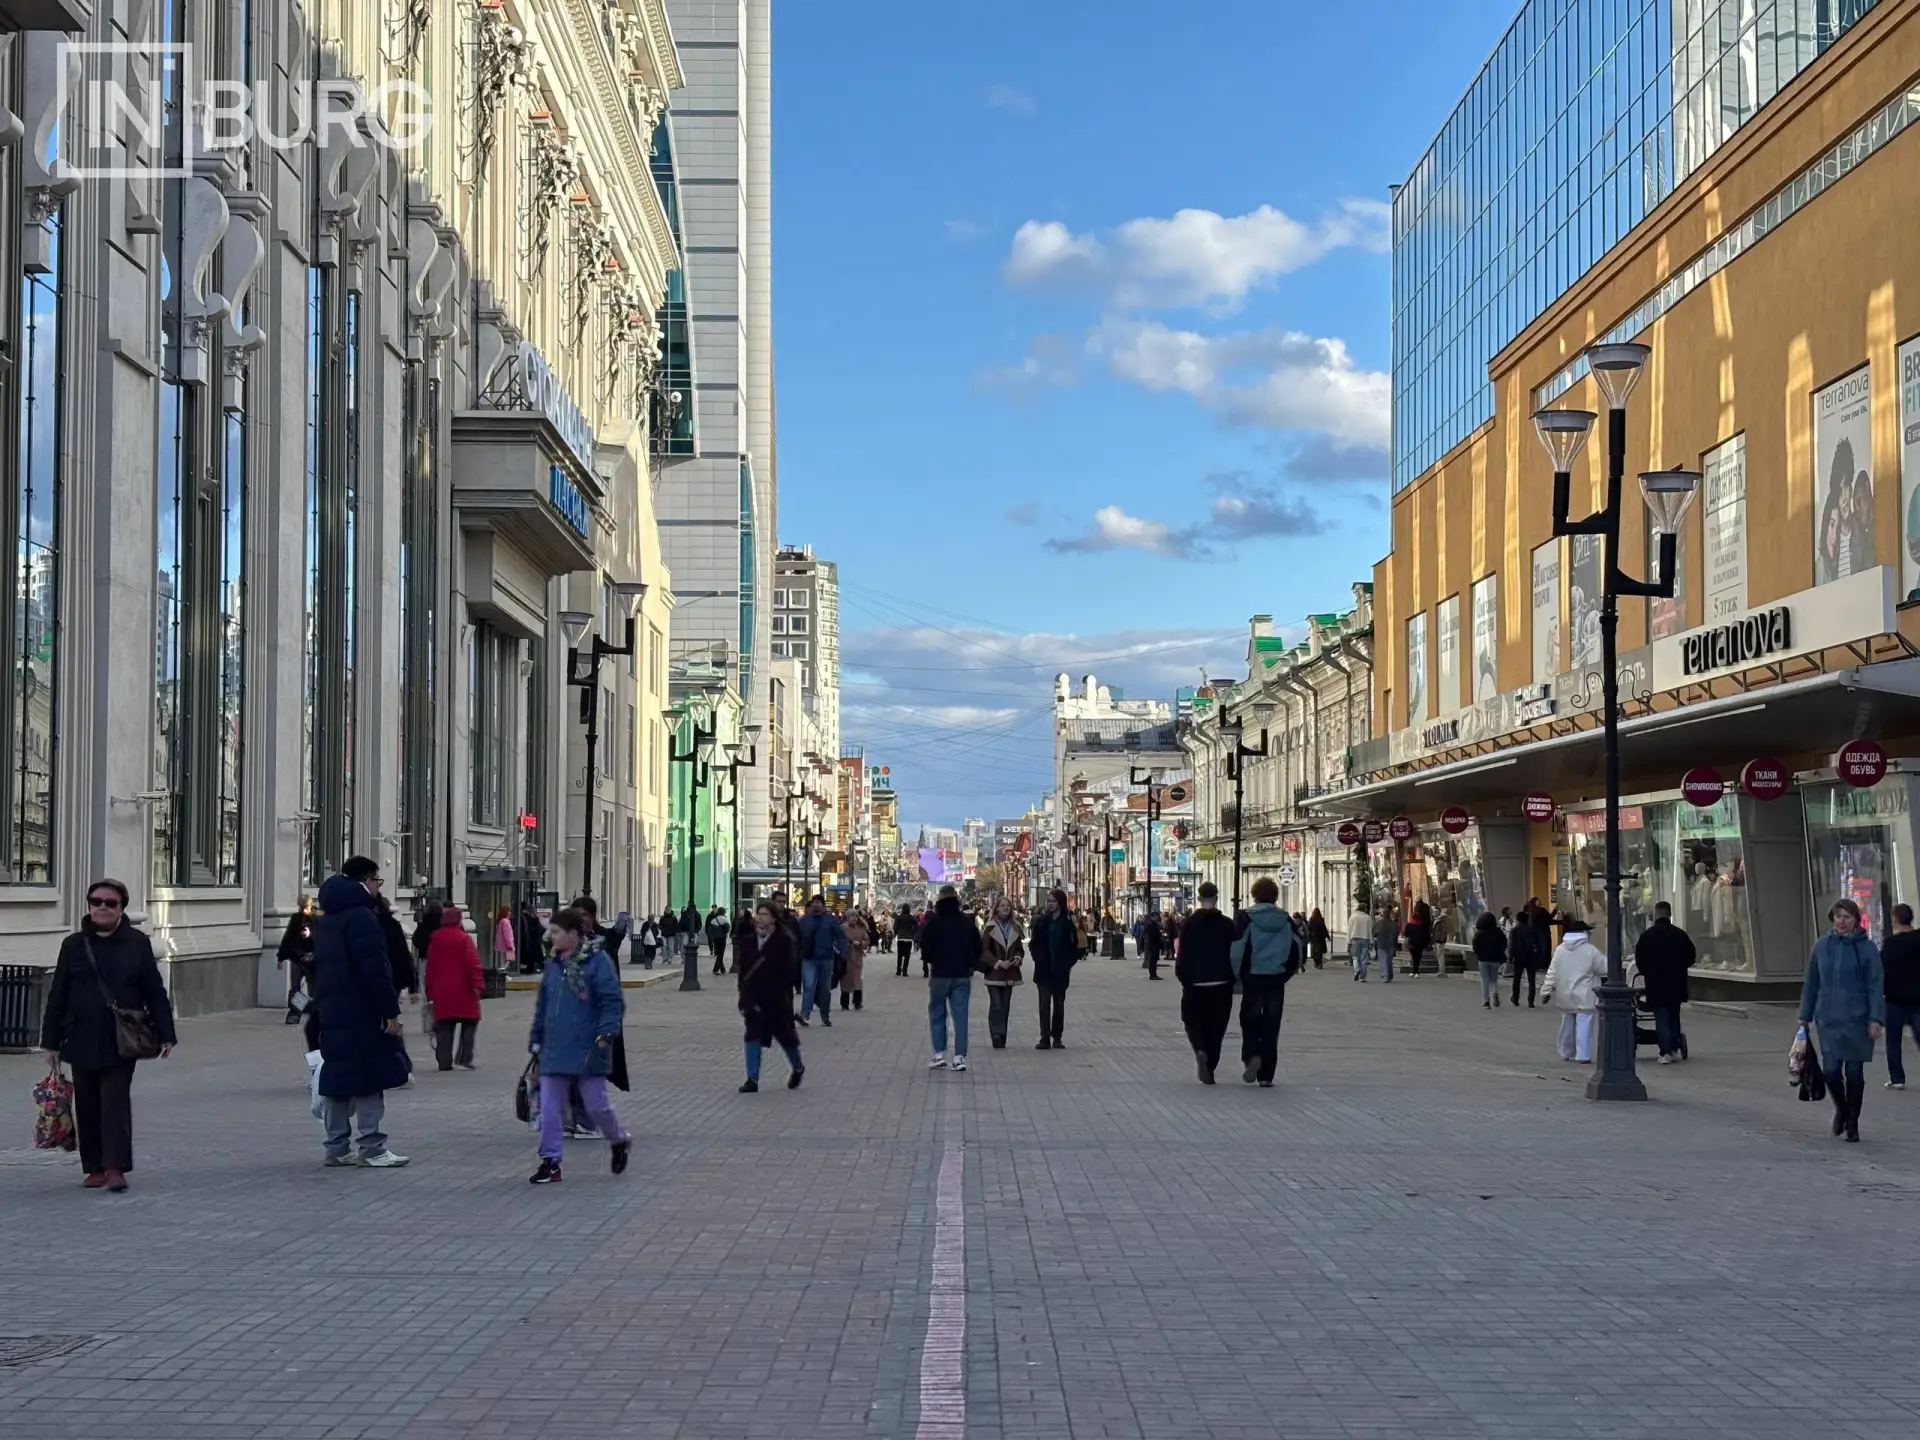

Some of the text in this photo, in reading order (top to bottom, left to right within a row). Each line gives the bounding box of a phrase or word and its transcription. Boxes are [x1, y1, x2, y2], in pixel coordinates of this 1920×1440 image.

[1845, 752, 1880, 764] ОДЕЖДА
[1850, 764, 1876, 775] ОБУВЬ
[1754, 770, 1778, 780] ТКАНИ
[1685, 782, 1722, 791] SHOWROOMS
[1588, 814, 1606, 829] STOL
[1002, 836, 1015, 845] Spi
